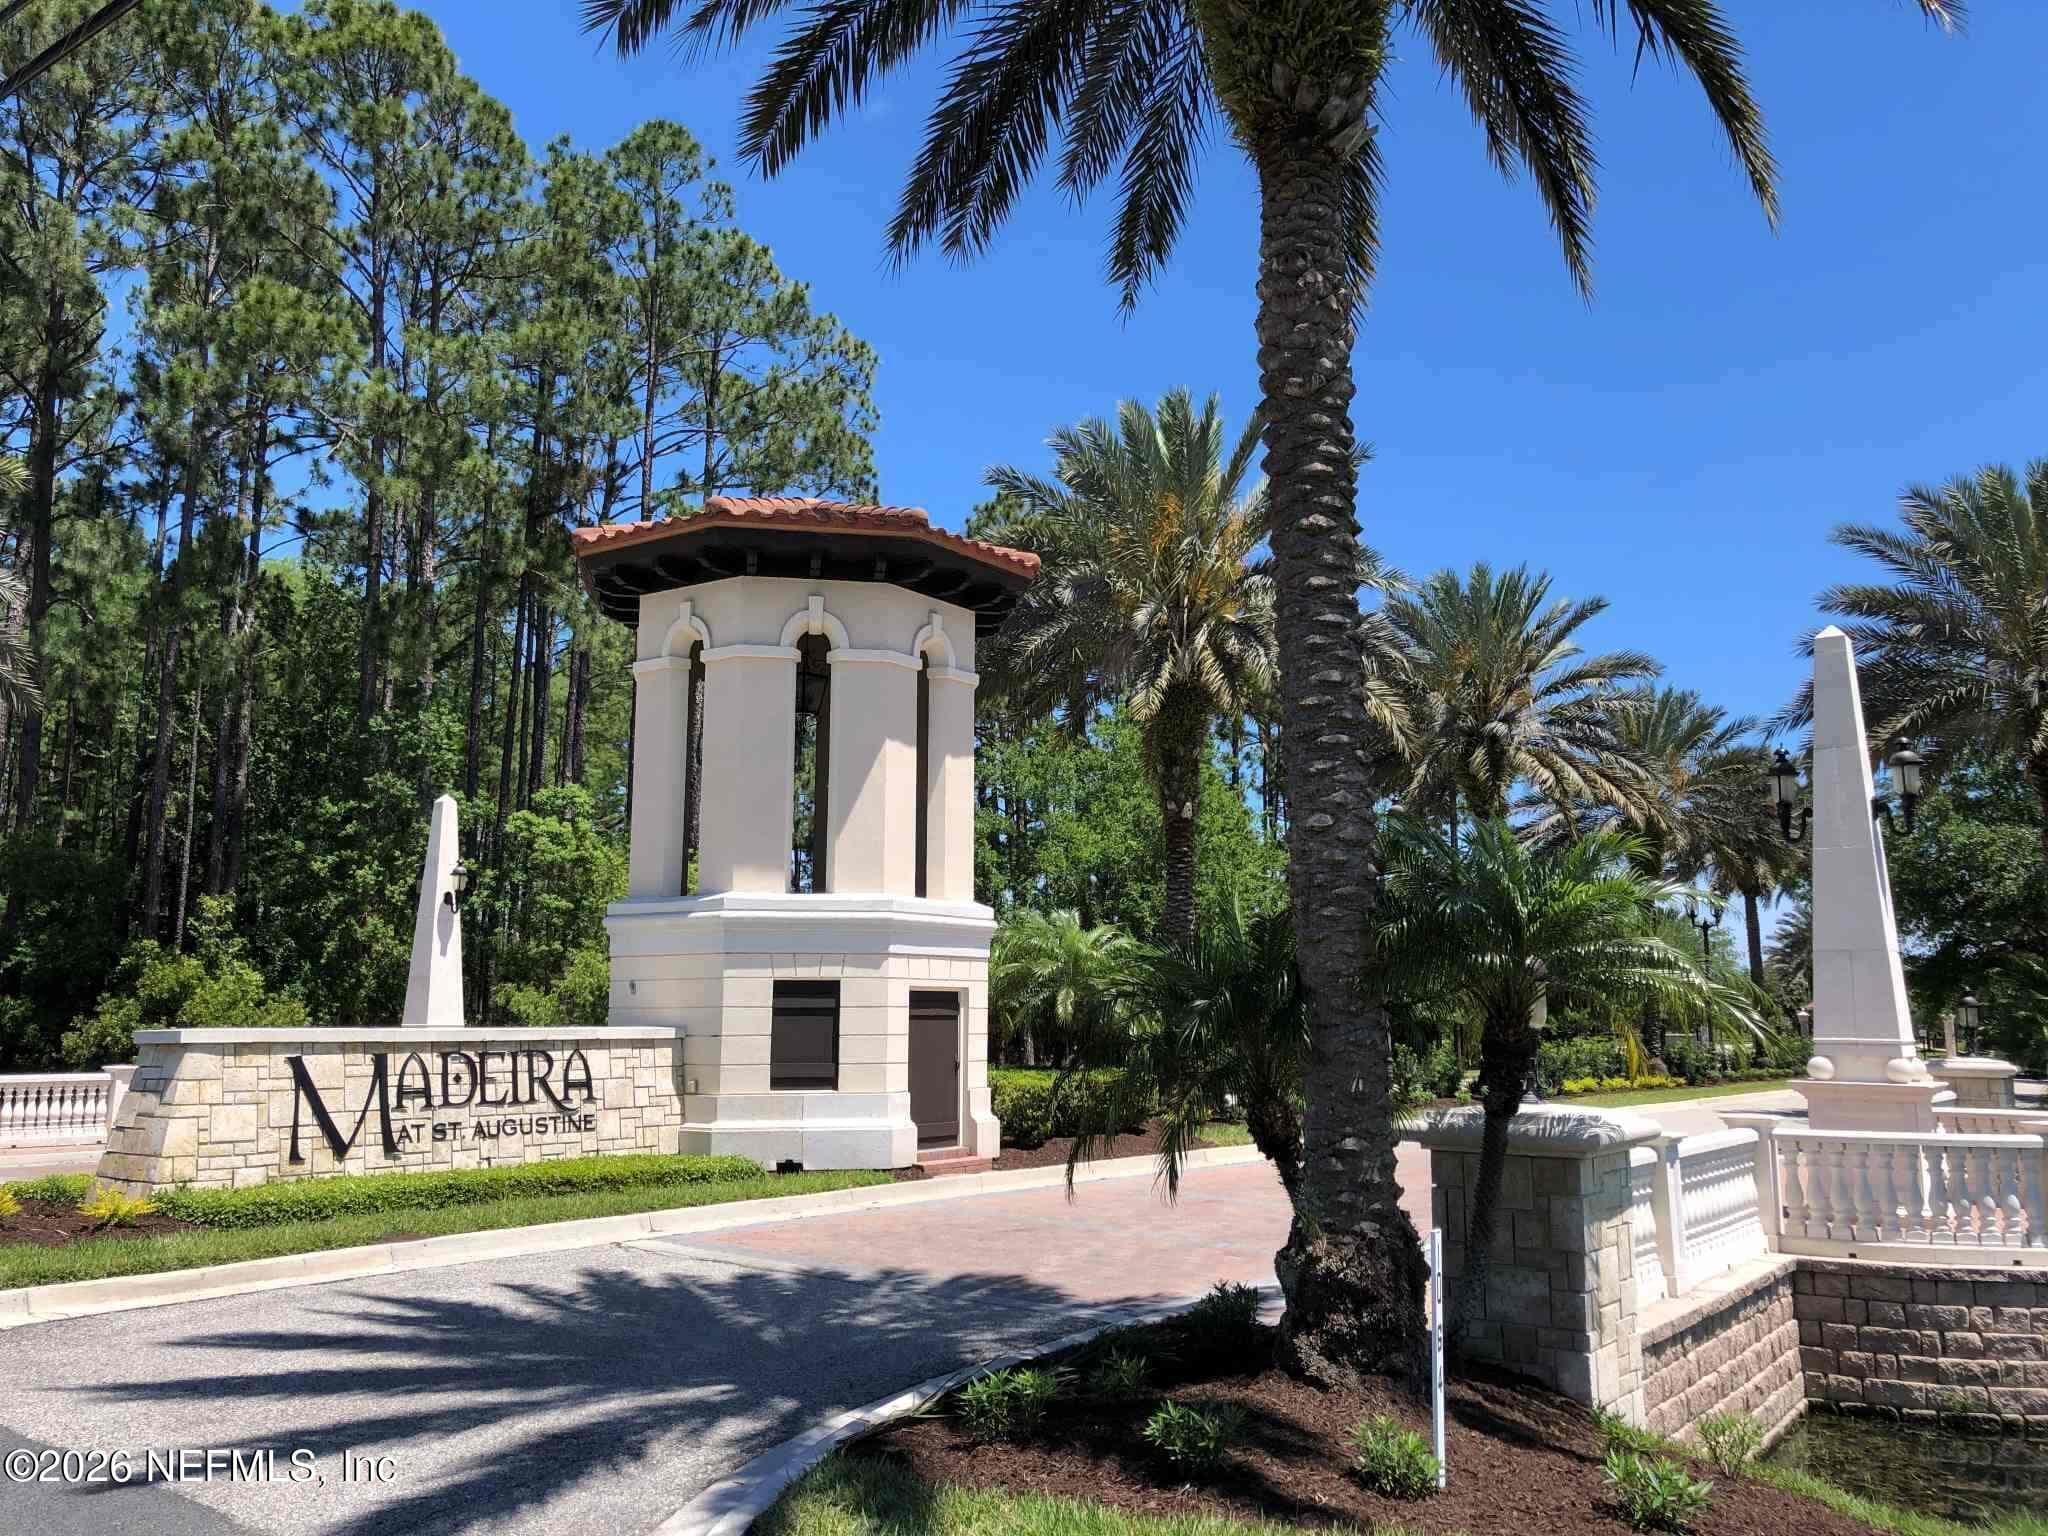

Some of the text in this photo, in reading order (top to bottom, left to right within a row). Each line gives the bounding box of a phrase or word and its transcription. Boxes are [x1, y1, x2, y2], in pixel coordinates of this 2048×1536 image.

[286, 1049, 600, 1164] MADEIRA
[396, 1114, 595, 1145] AT ST. AUGUSTINE
